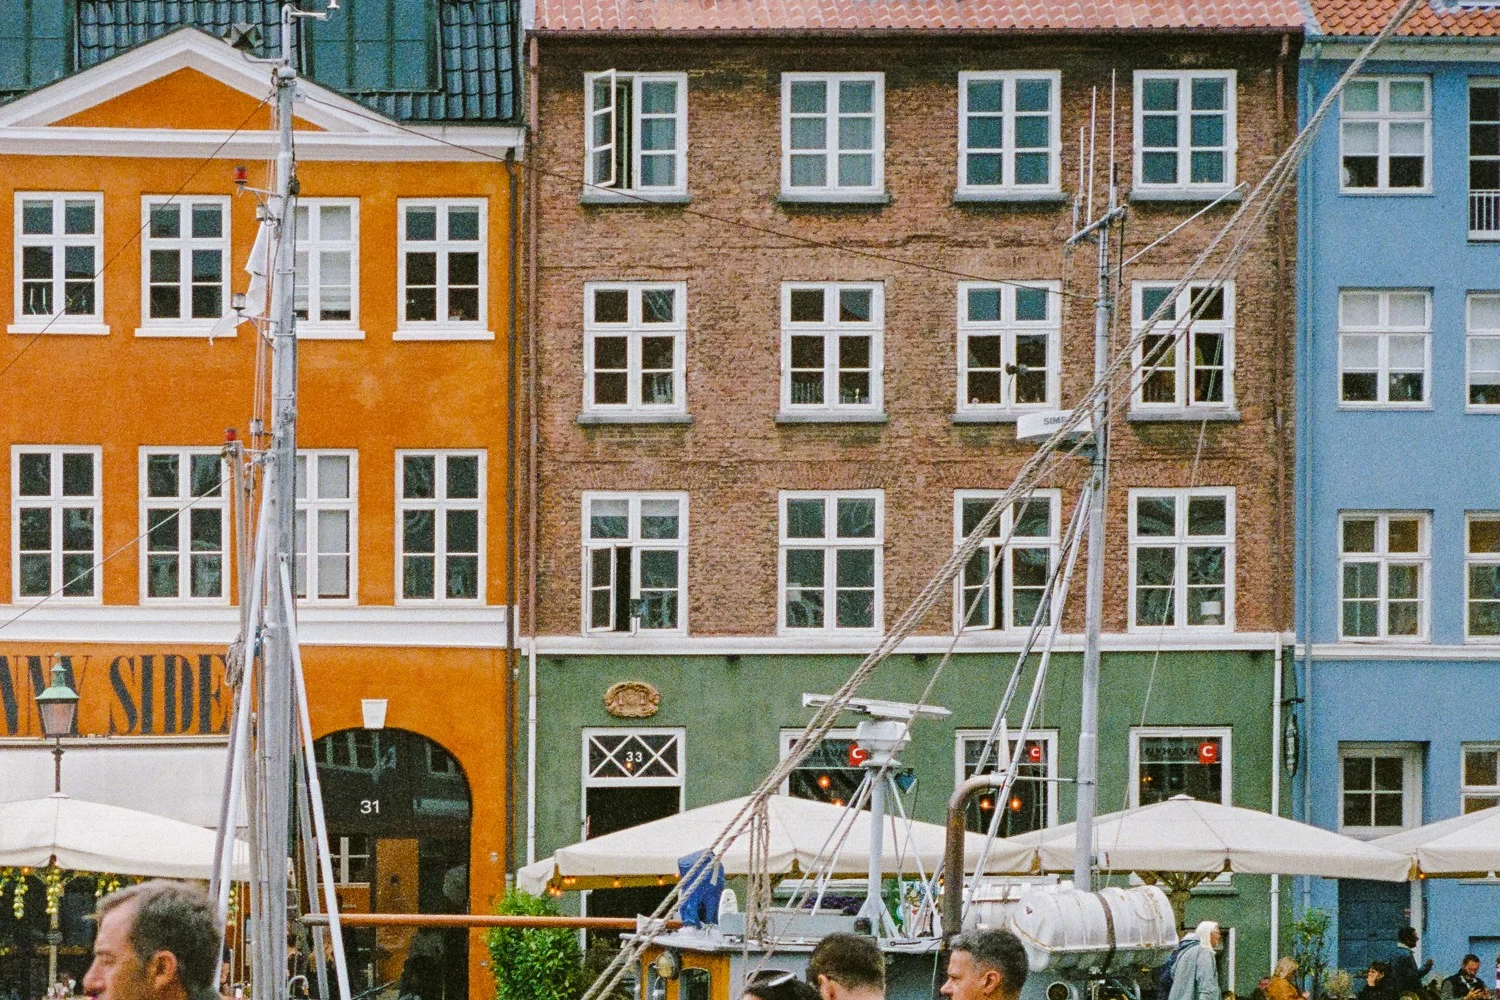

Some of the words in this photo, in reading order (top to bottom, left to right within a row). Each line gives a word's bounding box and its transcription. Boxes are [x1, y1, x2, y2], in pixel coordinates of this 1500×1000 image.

[108, 654, 235, 735] SIDE
[626, 751, 643, 762] 33
[360, 799, 380, 814] 31
